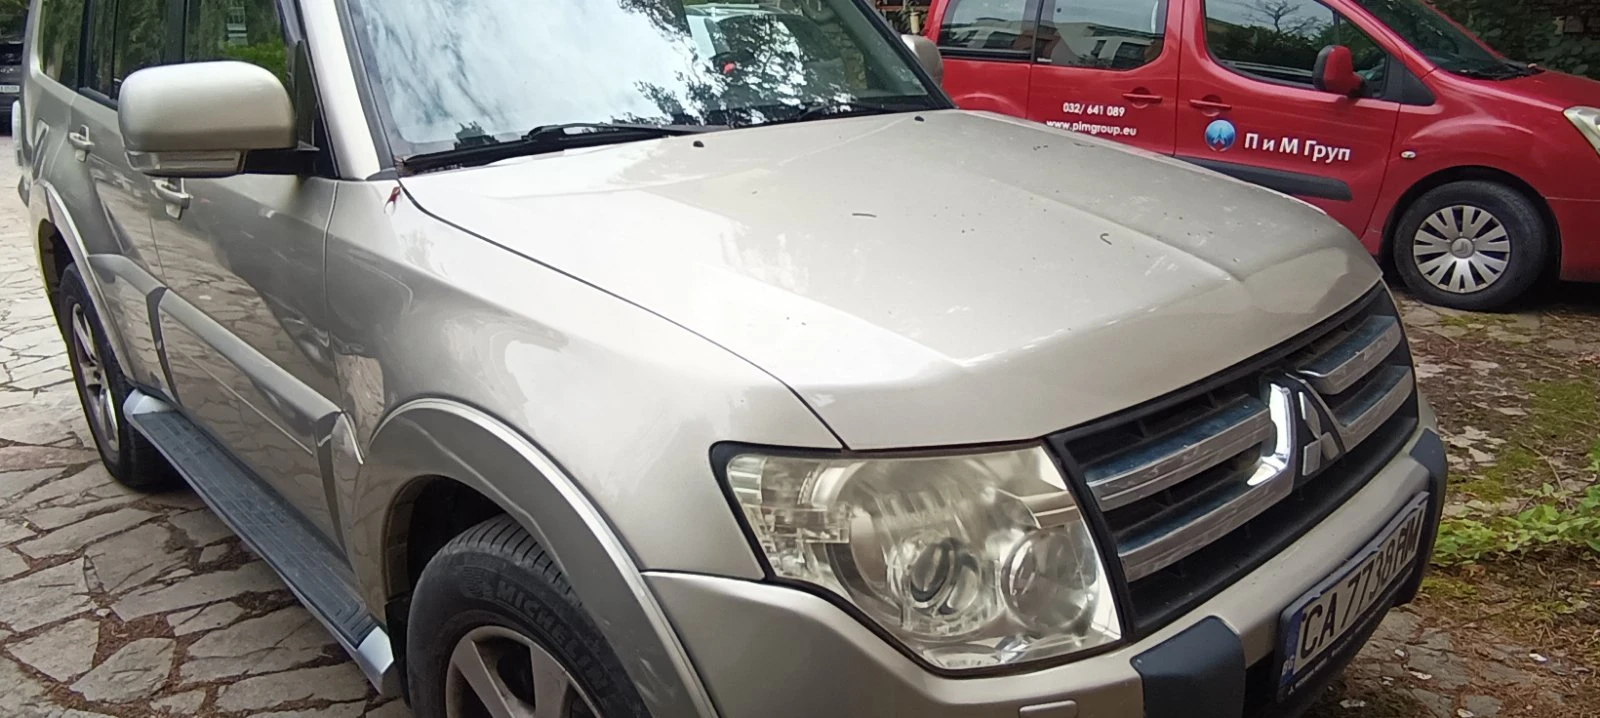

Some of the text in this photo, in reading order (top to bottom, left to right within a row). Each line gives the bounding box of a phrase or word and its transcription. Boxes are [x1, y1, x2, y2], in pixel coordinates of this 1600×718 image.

[1062, 102, 1126, 117] 032/ 641 089
[1046, 120, 1137, 136] www.pimgroup.eu
[1244, 132, 1351, 163] П и М Груп
[497, 580, 612, 694] MICHELIN
